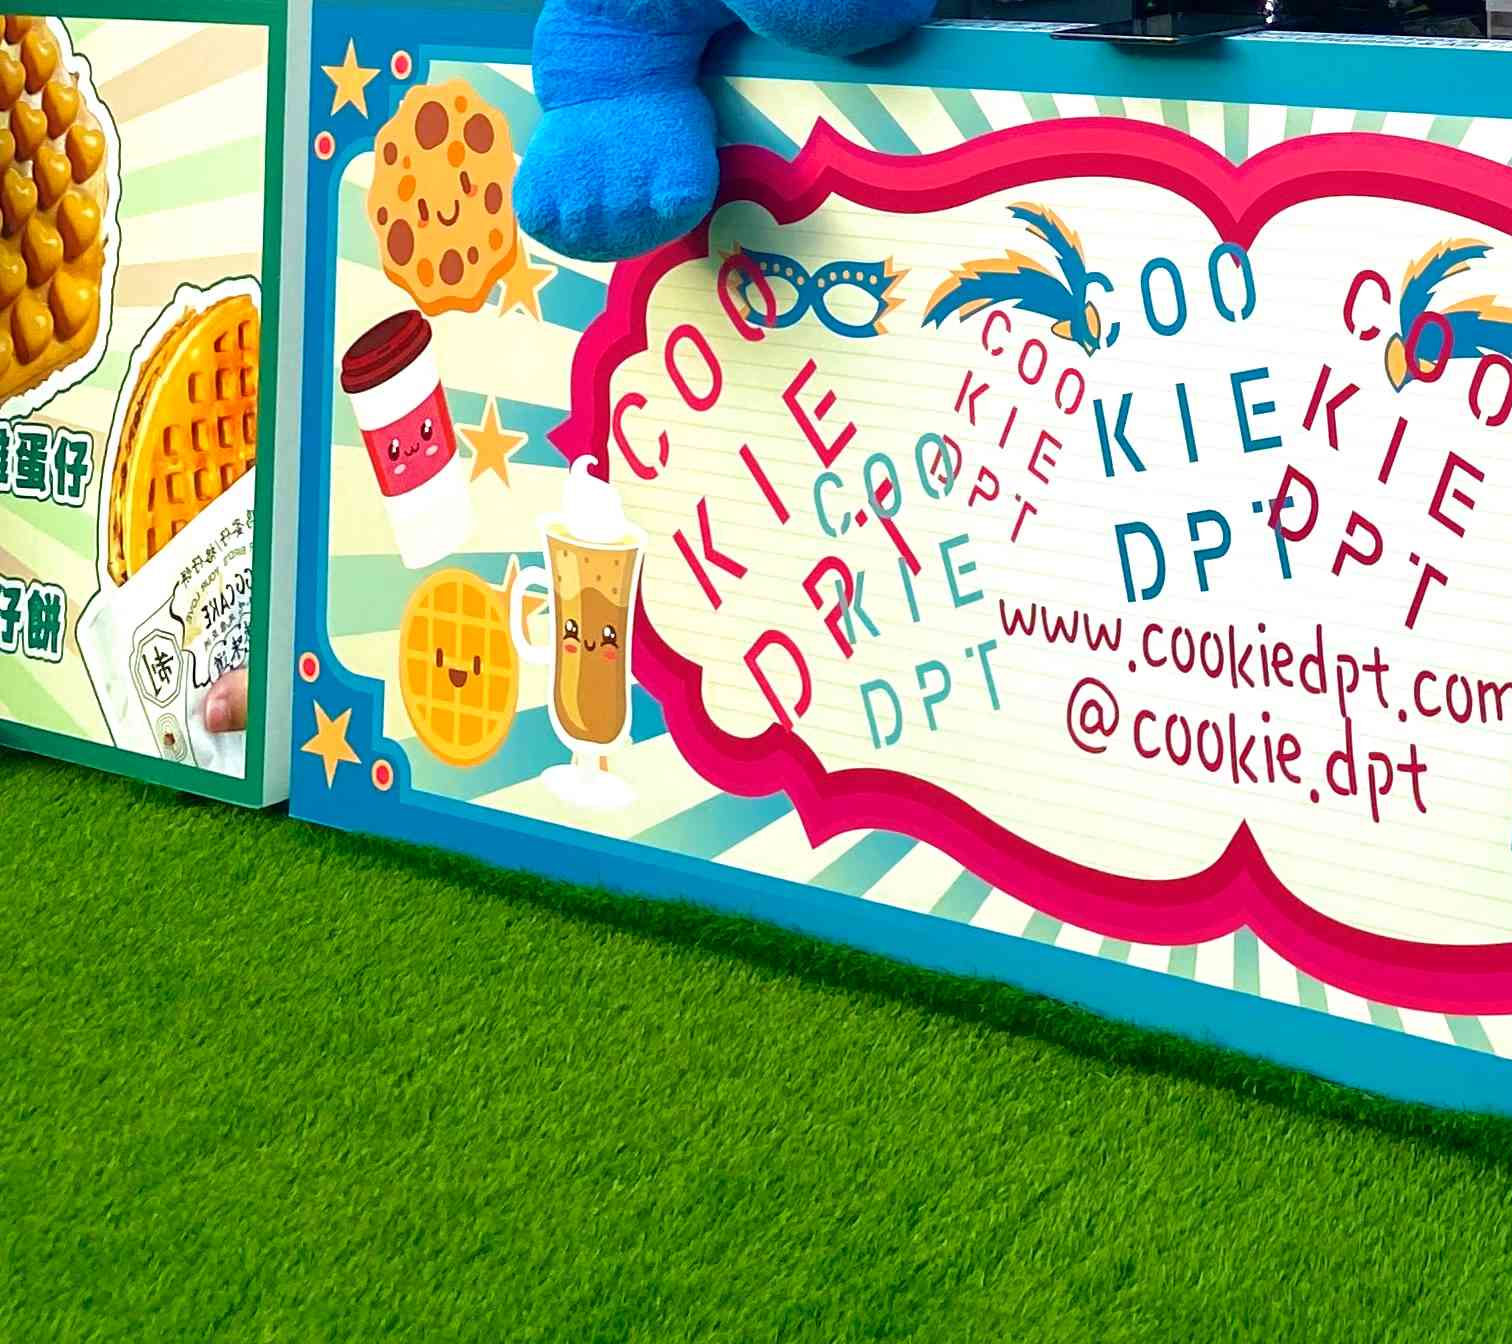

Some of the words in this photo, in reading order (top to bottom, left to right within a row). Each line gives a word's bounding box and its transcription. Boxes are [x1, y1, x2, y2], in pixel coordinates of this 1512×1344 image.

[613, 253, 776, 480] COO
[982, 310, 1085, 415] COO
[953, 370, 1063, 484] KIE
[1093, 367, 1283, 478] KIE
[1302, 364, 1485, 538] KIE
[673, 359, 857, 610] KIE
[813, 432, 956, 538] COO
[835, 534, 985, 644] KIE
[1115, 496, 1296, 602] DPT
[1267, 464, 1449, 630] DPT
[860, 639, 1000, 749] DPT
[1066, 677, 1427, 822] @cookie.dpt
